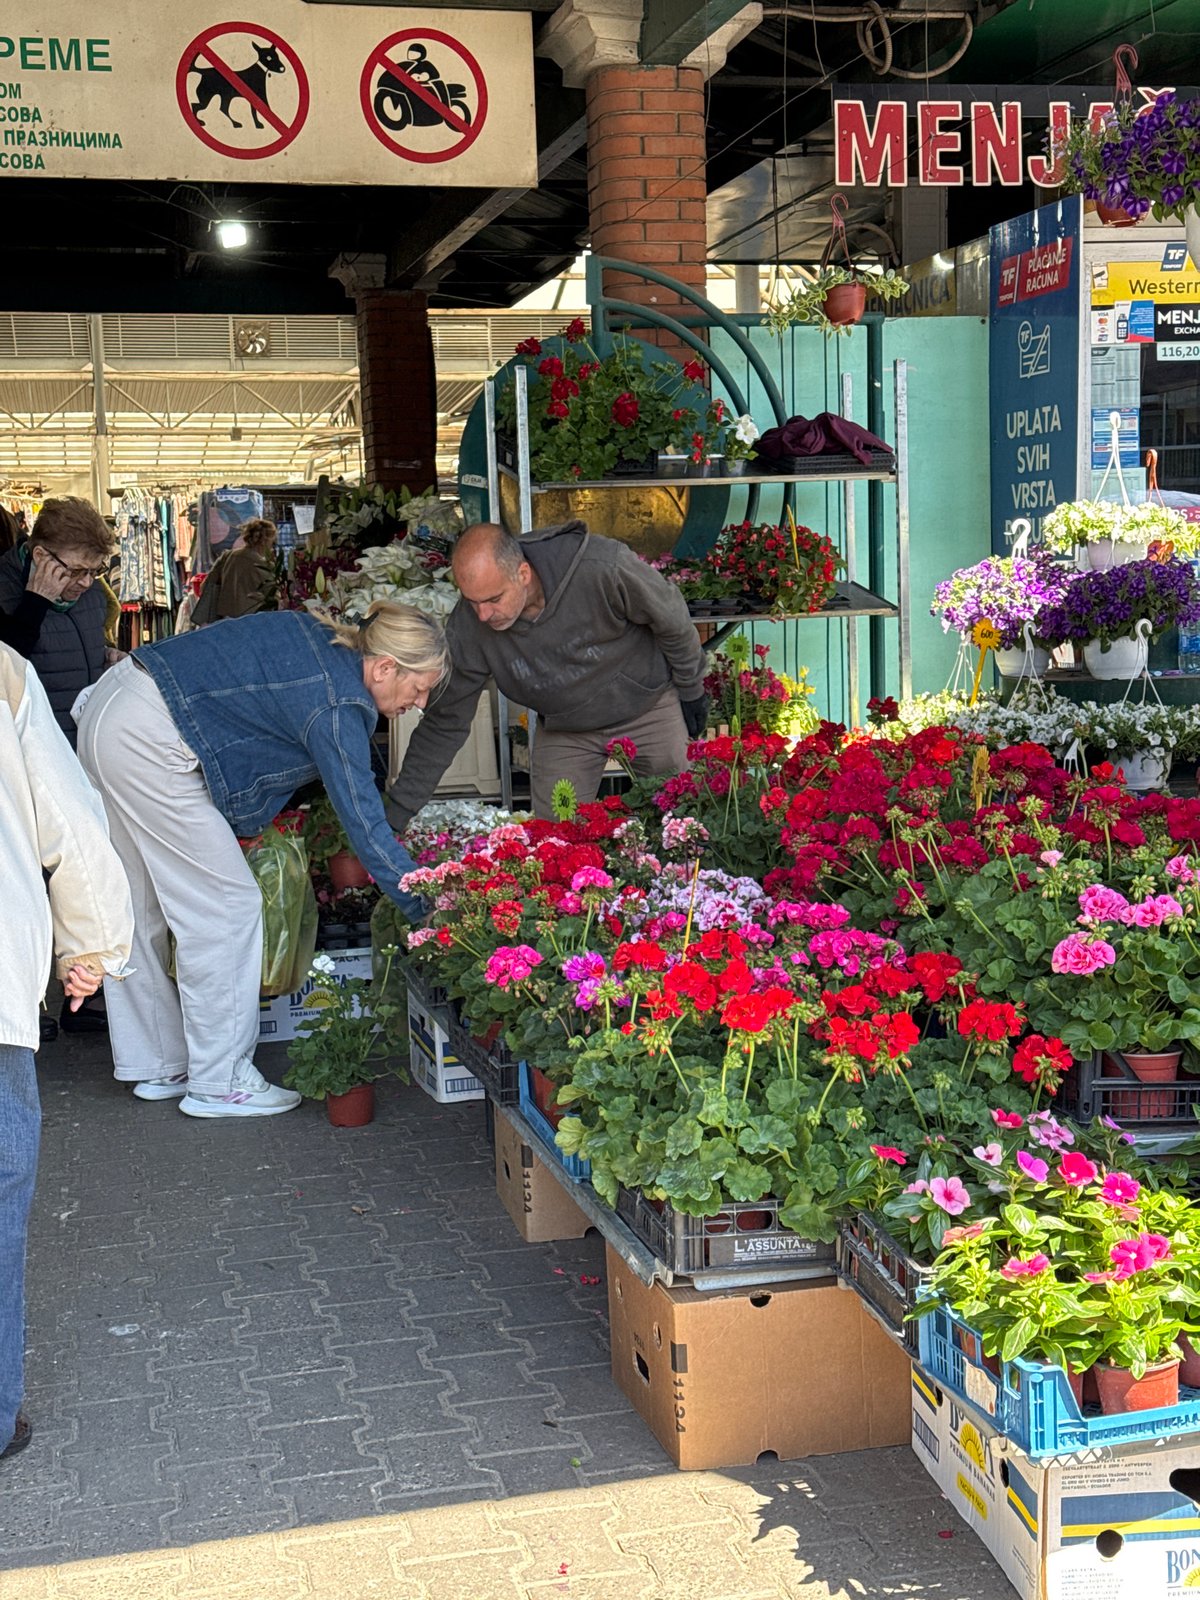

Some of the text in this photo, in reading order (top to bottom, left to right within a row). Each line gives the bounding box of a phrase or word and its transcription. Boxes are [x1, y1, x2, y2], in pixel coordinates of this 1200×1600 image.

[4, 129, 123, 151] ПРАЗНИЦИМА
[1168, 249, 1186, 260] TF
[1002, 267, 1016, 286] TF
[1025, 270, 1059, 293] RAČUNA
[1006, 404, 1062, 439] UPLATA
[1017, 443, 1050, 474] SVIH
[1011, 479, 1056, 510] VRSTA
[980, 628, 994, 639] 600
